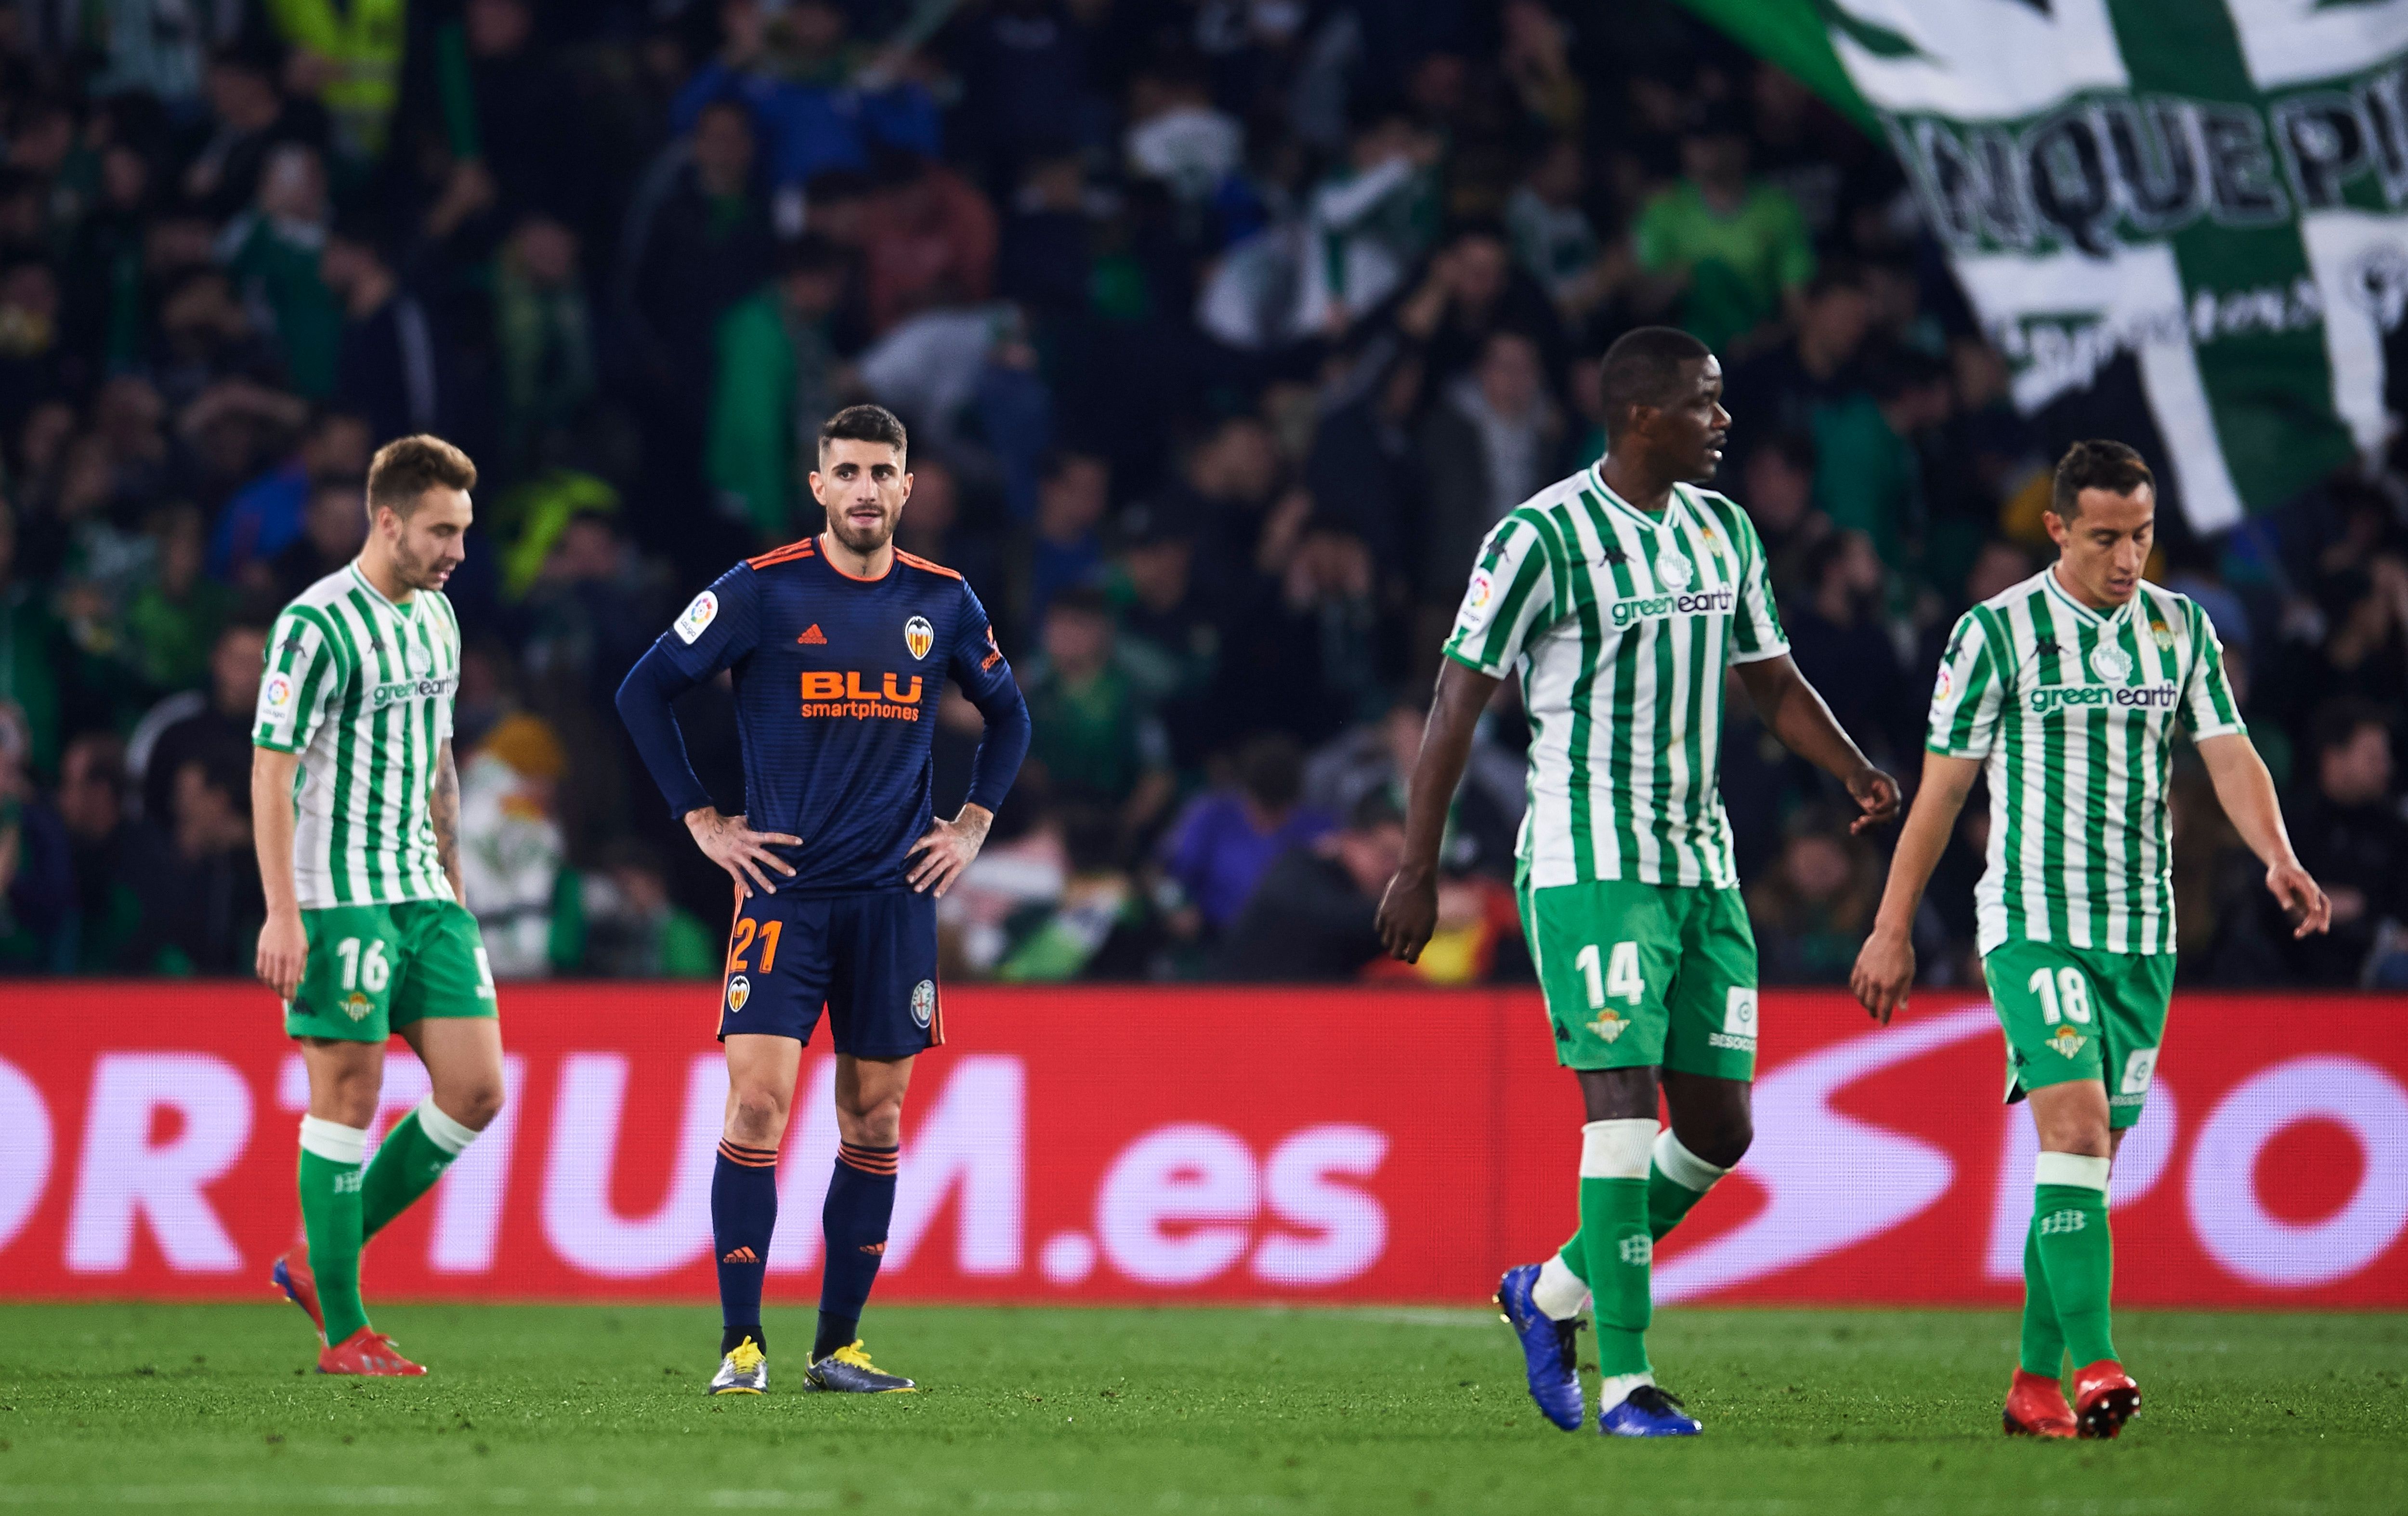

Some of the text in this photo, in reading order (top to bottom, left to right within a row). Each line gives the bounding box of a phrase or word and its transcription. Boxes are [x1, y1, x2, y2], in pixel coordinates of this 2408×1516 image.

[680, 618, 697, 637] LaLiga
[801, 671, 923, 703] BLU
[2030, 683, 2177, 712] greenearth
[801, 700, 919, 722] smartphones
[337, 936, 390, 992] 16
[730, 918, 783, 974] 21
[1575, 941, 1646, 1009] 14
[2028, 966, 2091, 1025] 18
